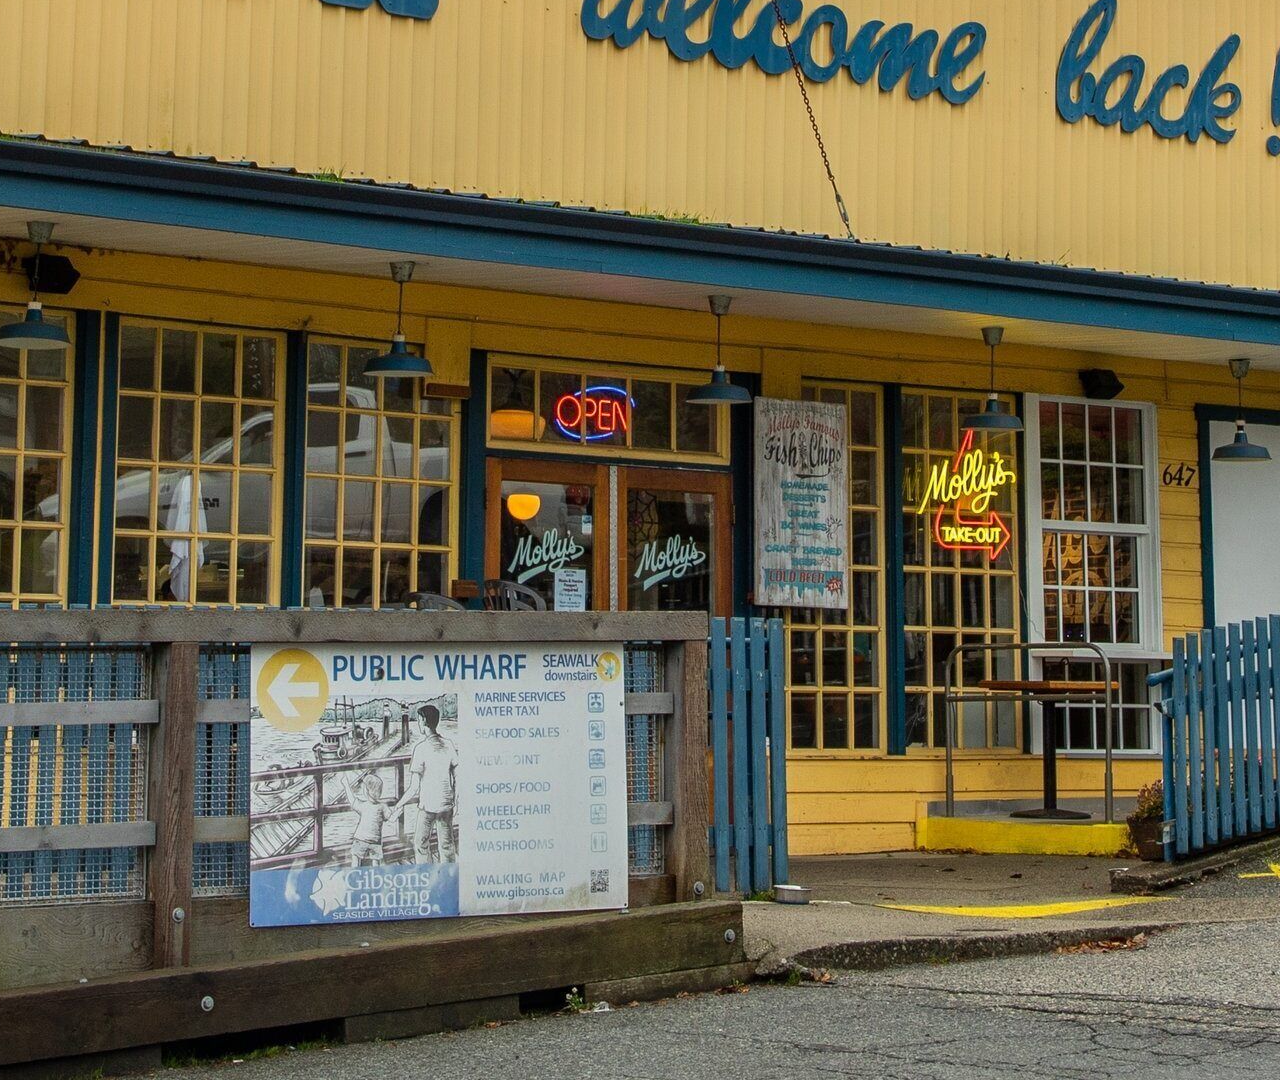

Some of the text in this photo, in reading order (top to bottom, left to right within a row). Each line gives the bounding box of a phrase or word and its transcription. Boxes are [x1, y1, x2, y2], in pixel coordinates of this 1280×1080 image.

[555, 394, 629, 432] OPEN
[764, 432, 842, 467] Fish Chips
[1162, 462, 1196, 487] 647
[781, 481, 829, 491] HOMEMADE
[917, 449, 1017, 514] Molly's
[782, 492, 826, 503] DESSERTS
[787, 509, 820, 519] GREAT
[799, 521, 827, 532] WINES
[940, 526, 1002, 543] TAKE-OUT
[507, 528, 585, 573] Molly's
[634, 534, 706, 579] Molly's
[765, 544, 842, 556] CRAFT BREWED
[791, 557, 817, 566] BEER
[769, 570, 825, 584] COLD BEER
[542, 653, 599, 668] SEAWALK
[332, 654, 527, 682] PUBLIC WHARF
[544, 669, 598, 681] downstairs
[474, 691, 566, 703] MARINE SERVICES
[475, 705, 539, 717] WATER TAXI
[475, 727, 560, 739] SEAFOOD SALES
[476, 754, 541, 766] VIEWOINT
[475, 783, 512, 794] SHOPS
[519, 781, 551, 793] FOOD
[476, 804, 551, 817] WHEELCHAIR
[476, 818, 519, 831] ACCESS
[476, 838, 555, 852] WASHROOMS
[345, 869, 430, 891] Gibsons
[476, 872, 566, 886] WALKING MAP
[476, 886, 565, 900] www.gibsons.ca
[345, 888, 432, 916] Landing
[332, 908, 418, 920] SEASIDE VILLAGE
